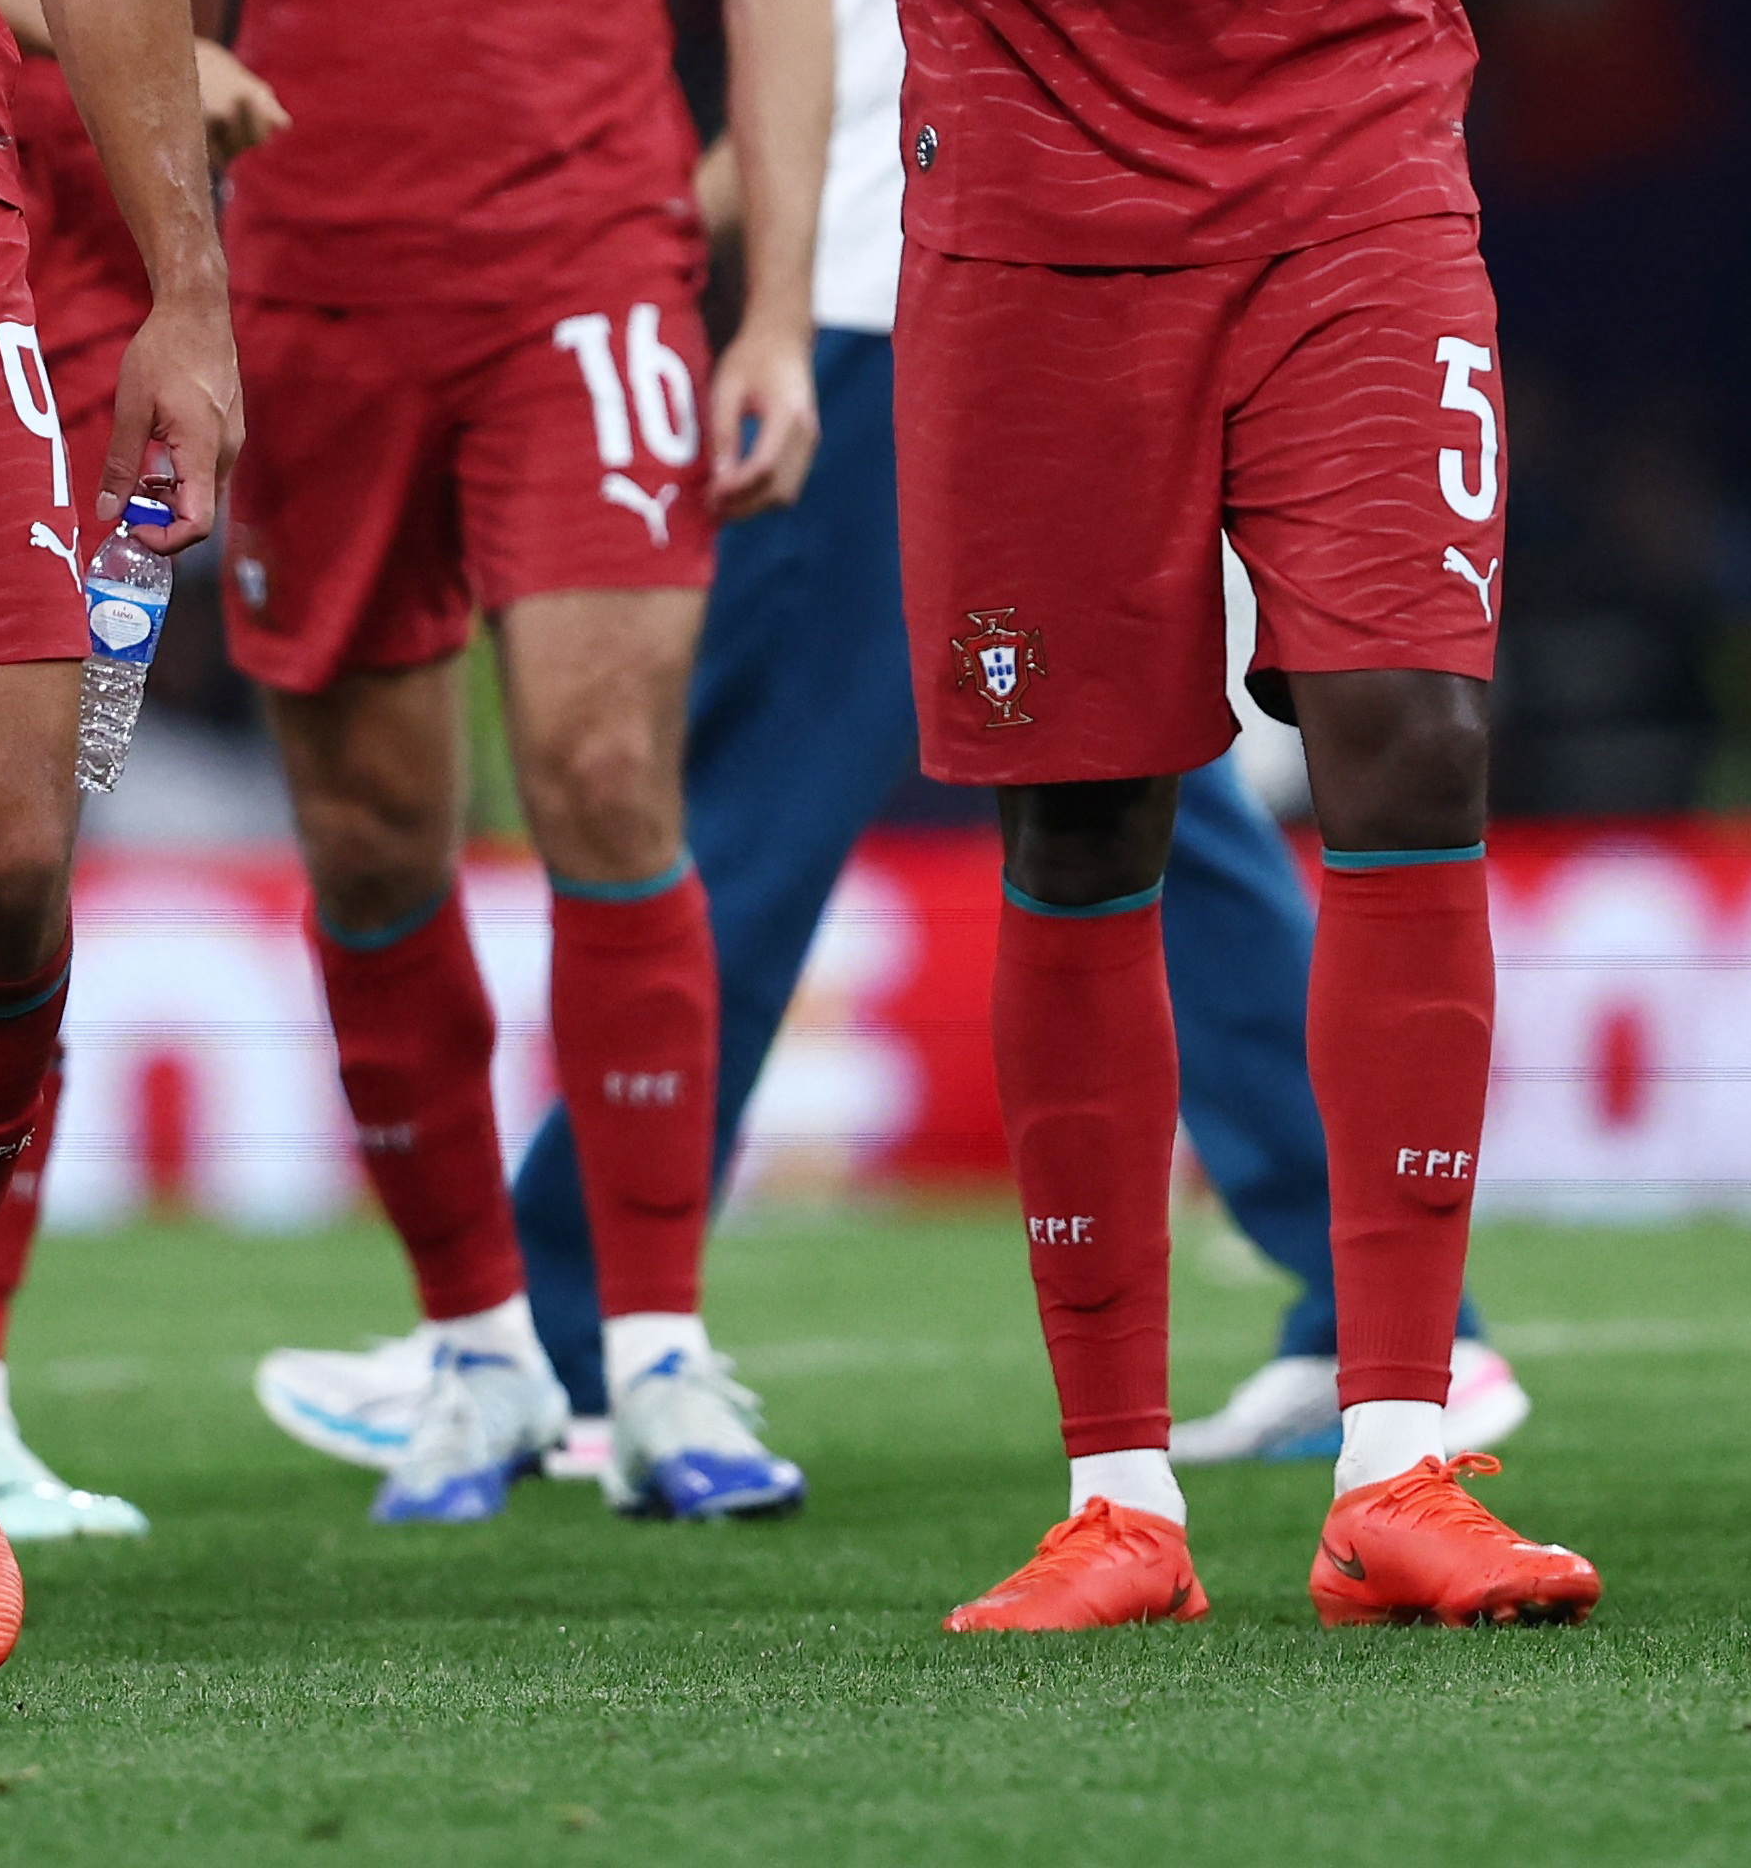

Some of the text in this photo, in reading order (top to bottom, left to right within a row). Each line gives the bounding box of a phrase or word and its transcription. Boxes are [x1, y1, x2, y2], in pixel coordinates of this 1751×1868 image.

[554, 302, 698, 468] 16
[1435, 336, 1499, 523] 5
[1396, 1147, 1474, 1180] F.P.F.
[1029, 1215, 1095, 1245] F.P.F.
